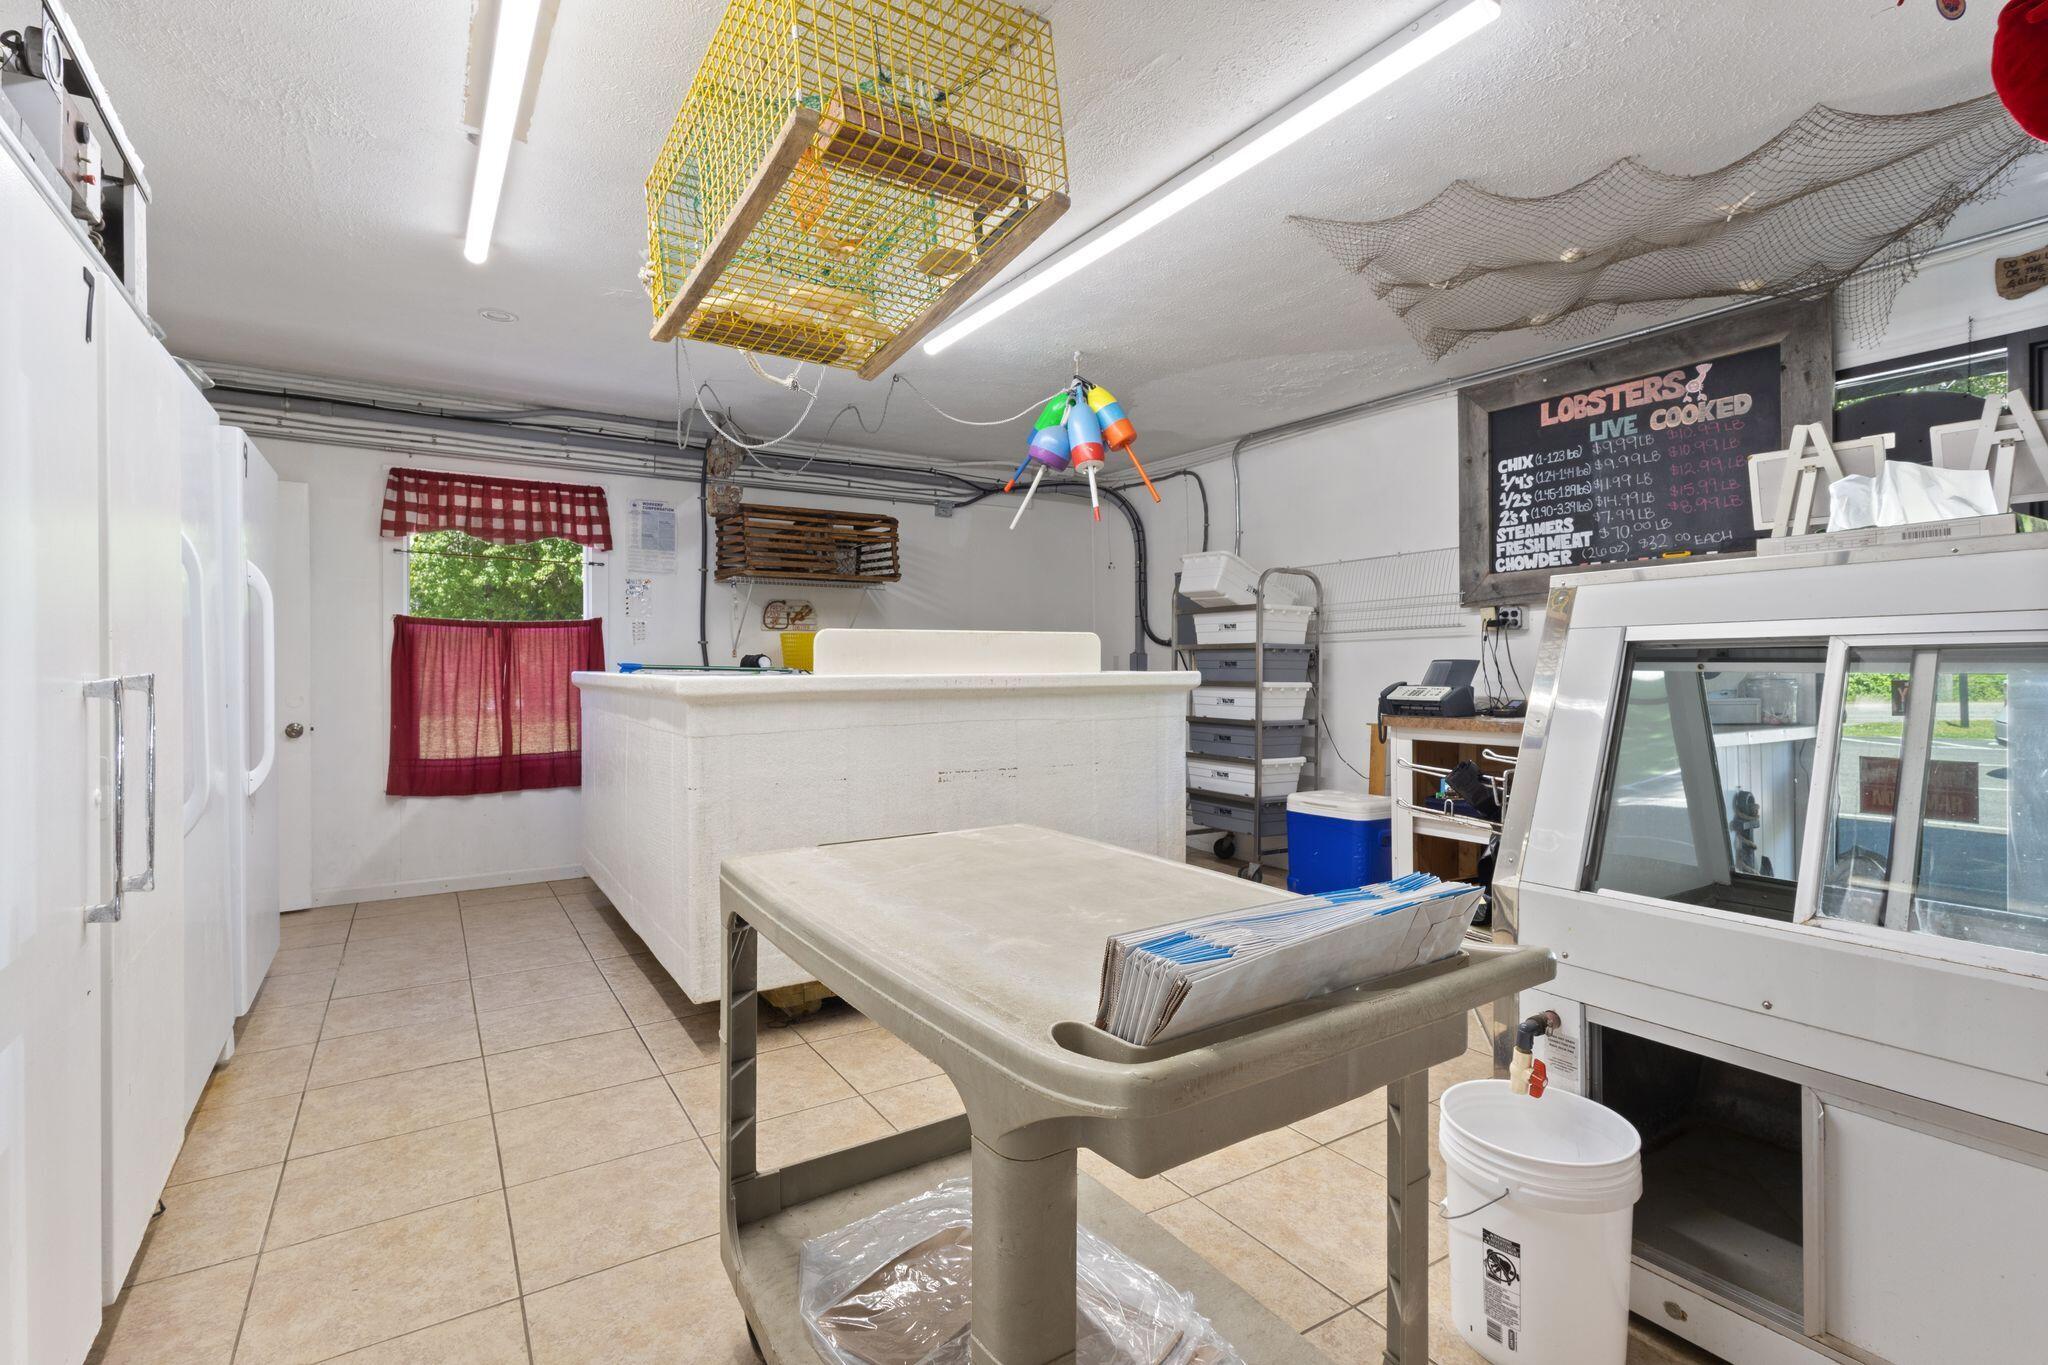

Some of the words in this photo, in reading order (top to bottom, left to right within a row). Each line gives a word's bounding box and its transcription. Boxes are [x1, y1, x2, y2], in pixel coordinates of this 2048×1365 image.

[1540, 371, 1686, 427] LOBSTERS
[1589, 414, 1638, 441] LIVE
[1650, 393, 1752, 431] COOKED
[1497, 454, 1534, 473] CHIX
[1592, 435, 1637, 455] $9.99
[1724, 419, 1744, 431] LB
[1500, 473, 1534, 492] 1/4's
[1594, 453, 1641, 470] $9.99
[1642, 450, 1661, 463] LB
[1722, 438, 1740, 450] LB
[1499, 491, 1533, 509] 1/2's
[1593, 473, 1631, 492] $11.99
[1636, 472, 1653, 485] LB
[1499, 510, 1519, 527] 2's
[1595, 491, 1639, 507] $14.99
[1641, 492, 1656, 504] LB
[1722, 479, 1741, 490] LB
[1496, 517, 1575, 542] STEAMERS
[1593, 508, 1635, 523] $7.99
[1638, 507, 1656, 519] LB
[1724, 495, 1744, 507] LB
[1496, 536, 1546, 558] FRESH
[1546, 530, 1594, 552] MEAT
[1599, 522, 1651, 539] $70.00
[1655, 518, 1673, 531] LB
[1495, 549, 1573, 573] CHOWDER
[1694, 530, 1733, 545] EACH
